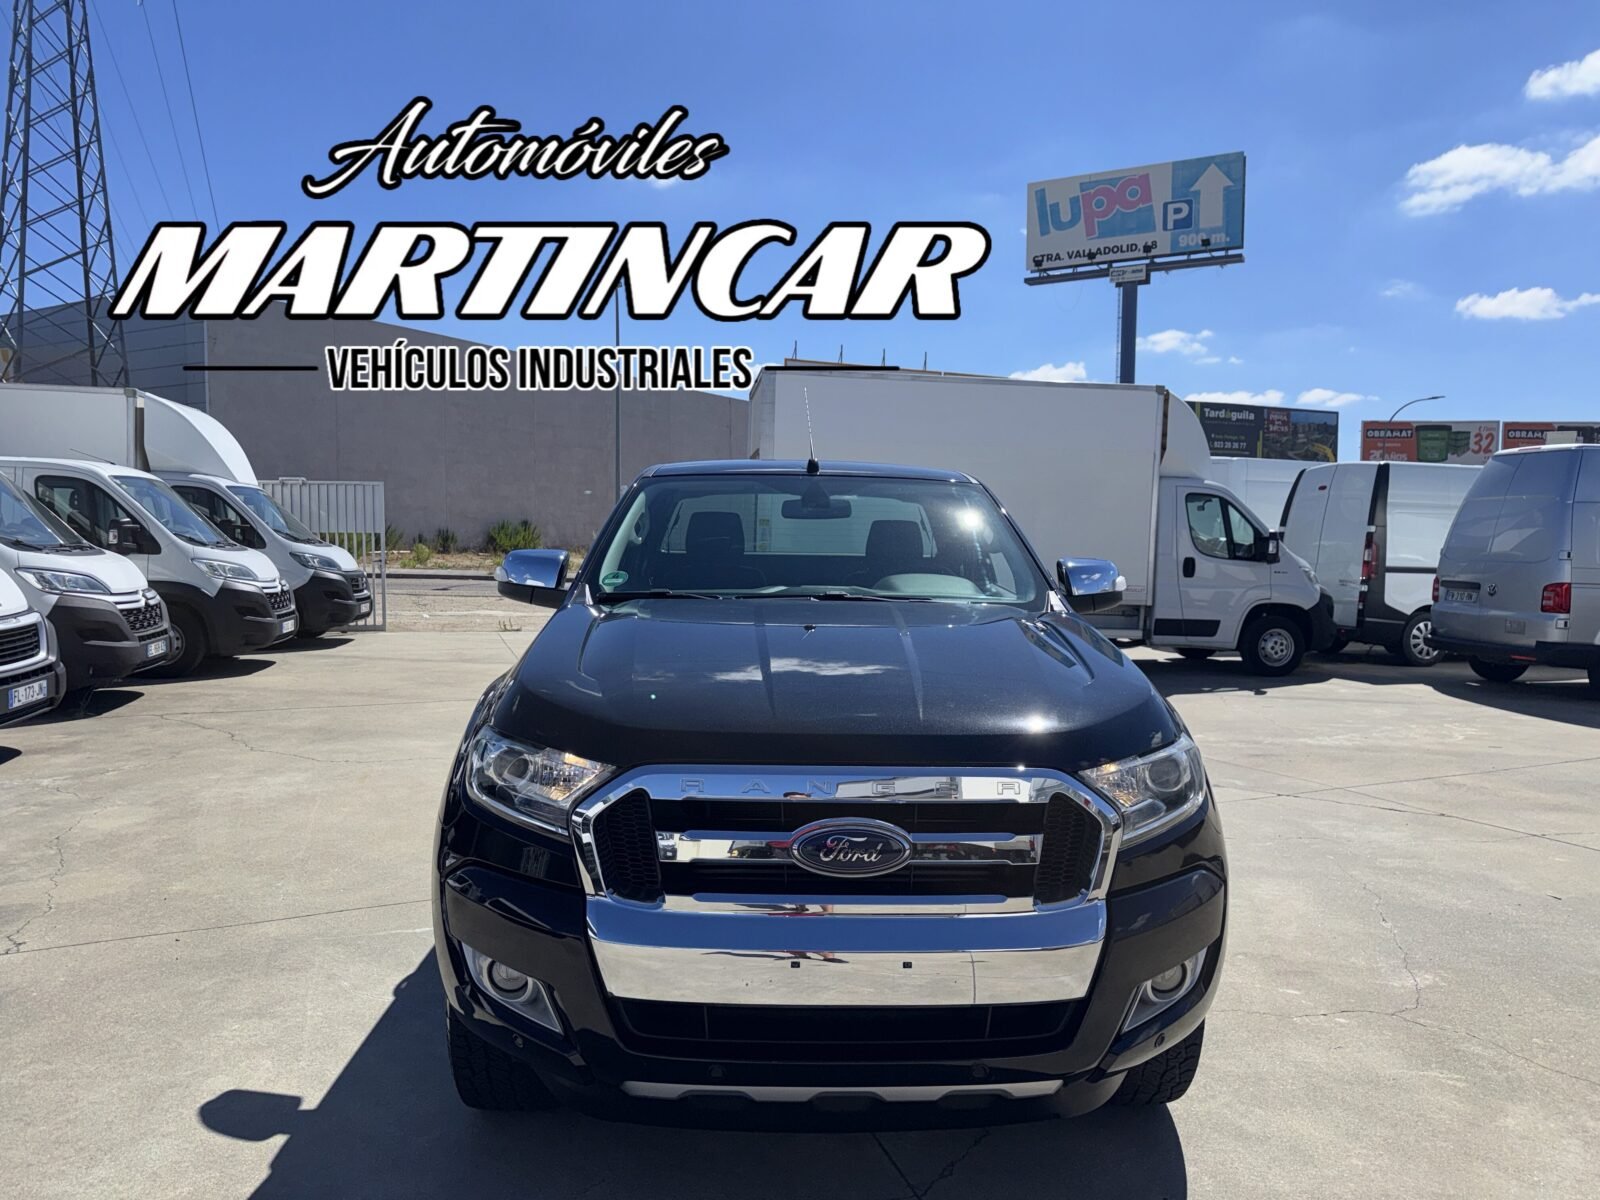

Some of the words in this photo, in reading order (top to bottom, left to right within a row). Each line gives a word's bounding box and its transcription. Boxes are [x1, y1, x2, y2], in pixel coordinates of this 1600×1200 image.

[1035, 173, 1152, 240] lupa
[1167, 203, 1190, 229] P
[1367, 430, 1413, 438] OBRAMAT
[1471, 431, 1494, 454] 32
[680, 778, 1021, 795] RANGER
[820, 835, 883, 862] Ford
